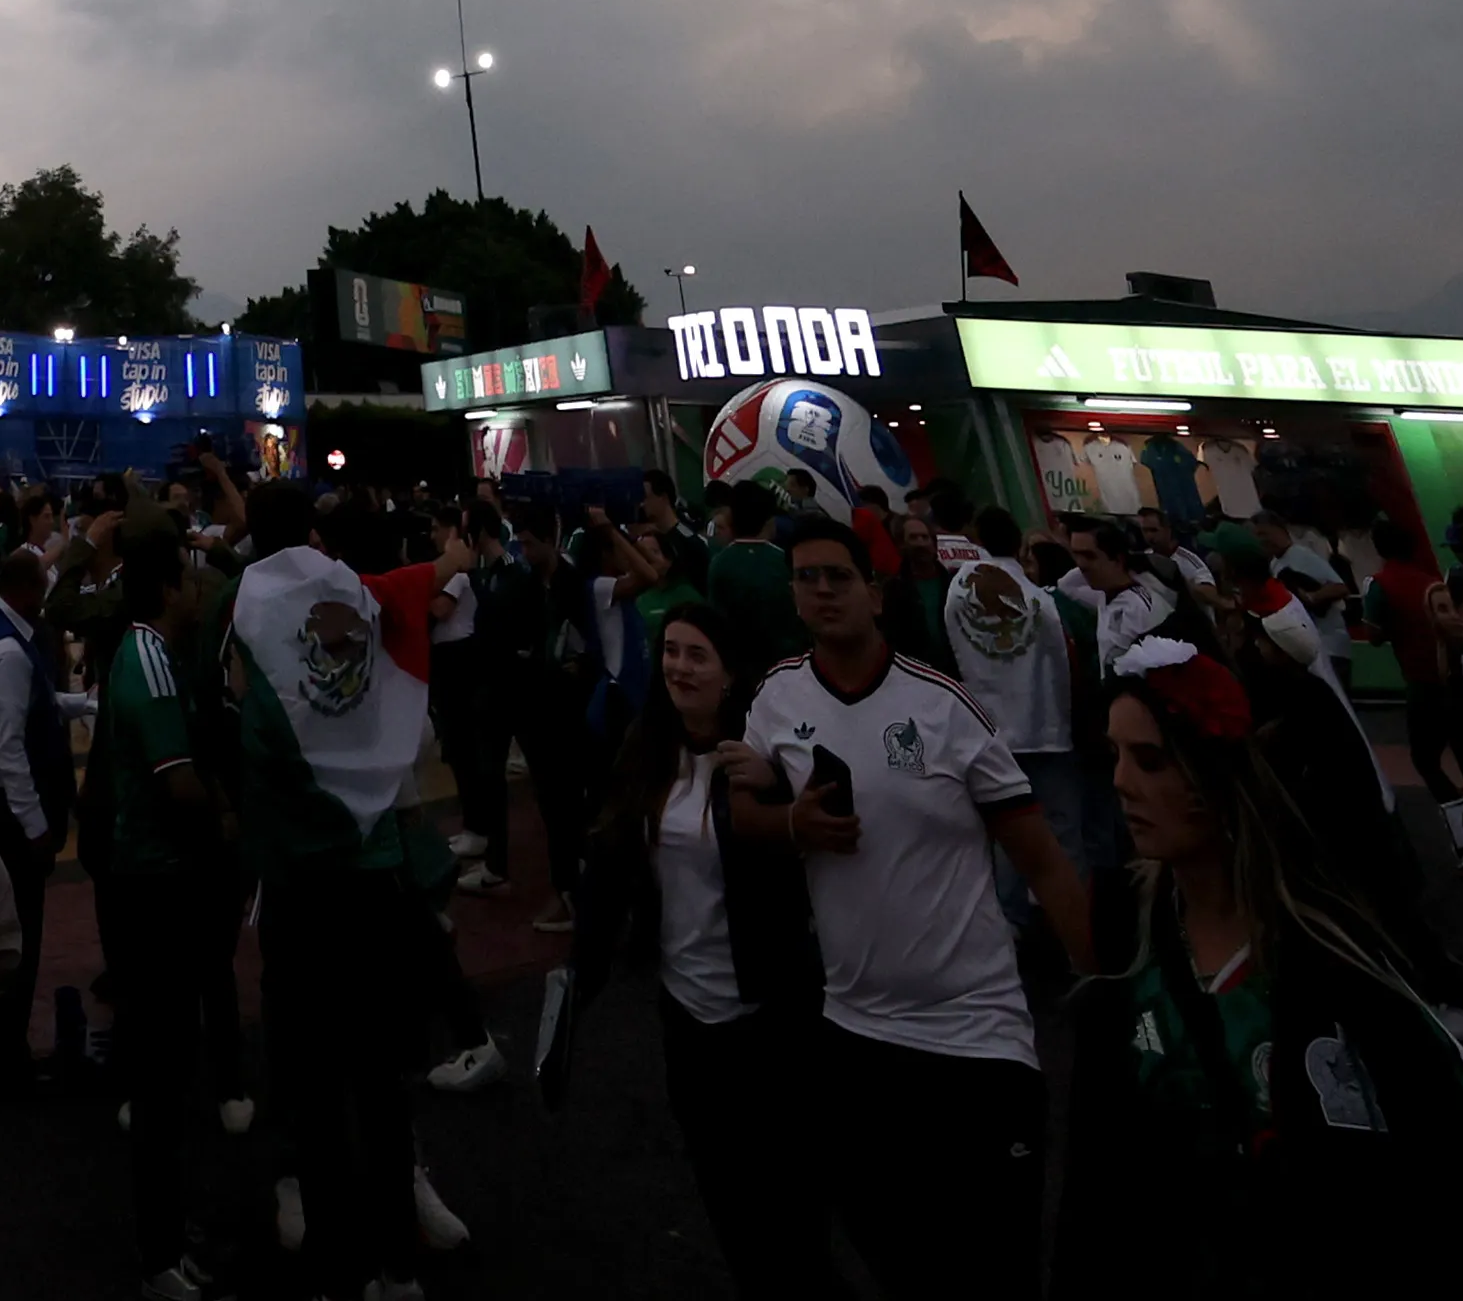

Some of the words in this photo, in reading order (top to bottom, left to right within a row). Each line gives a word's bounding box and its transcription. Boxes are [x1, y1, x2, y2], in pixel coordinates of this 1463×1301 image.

[255, 342, 280, 360] VISA
[668, 306, 880, 381] TRIONDA
[5, 358, 19, 376] in
[122, 361, 150, 384] tap
[150, 362, 166, 380] in
[255, 363, 276, 385] tap
[276, 365, 287, 382] in
[503, 354, 560, 393] MÉXICO
[1109, 343, 1234, 386] FÚTBOL
[1236, 351, 1326, 389] PARA
[1326, 356, 1370, 391] EL
